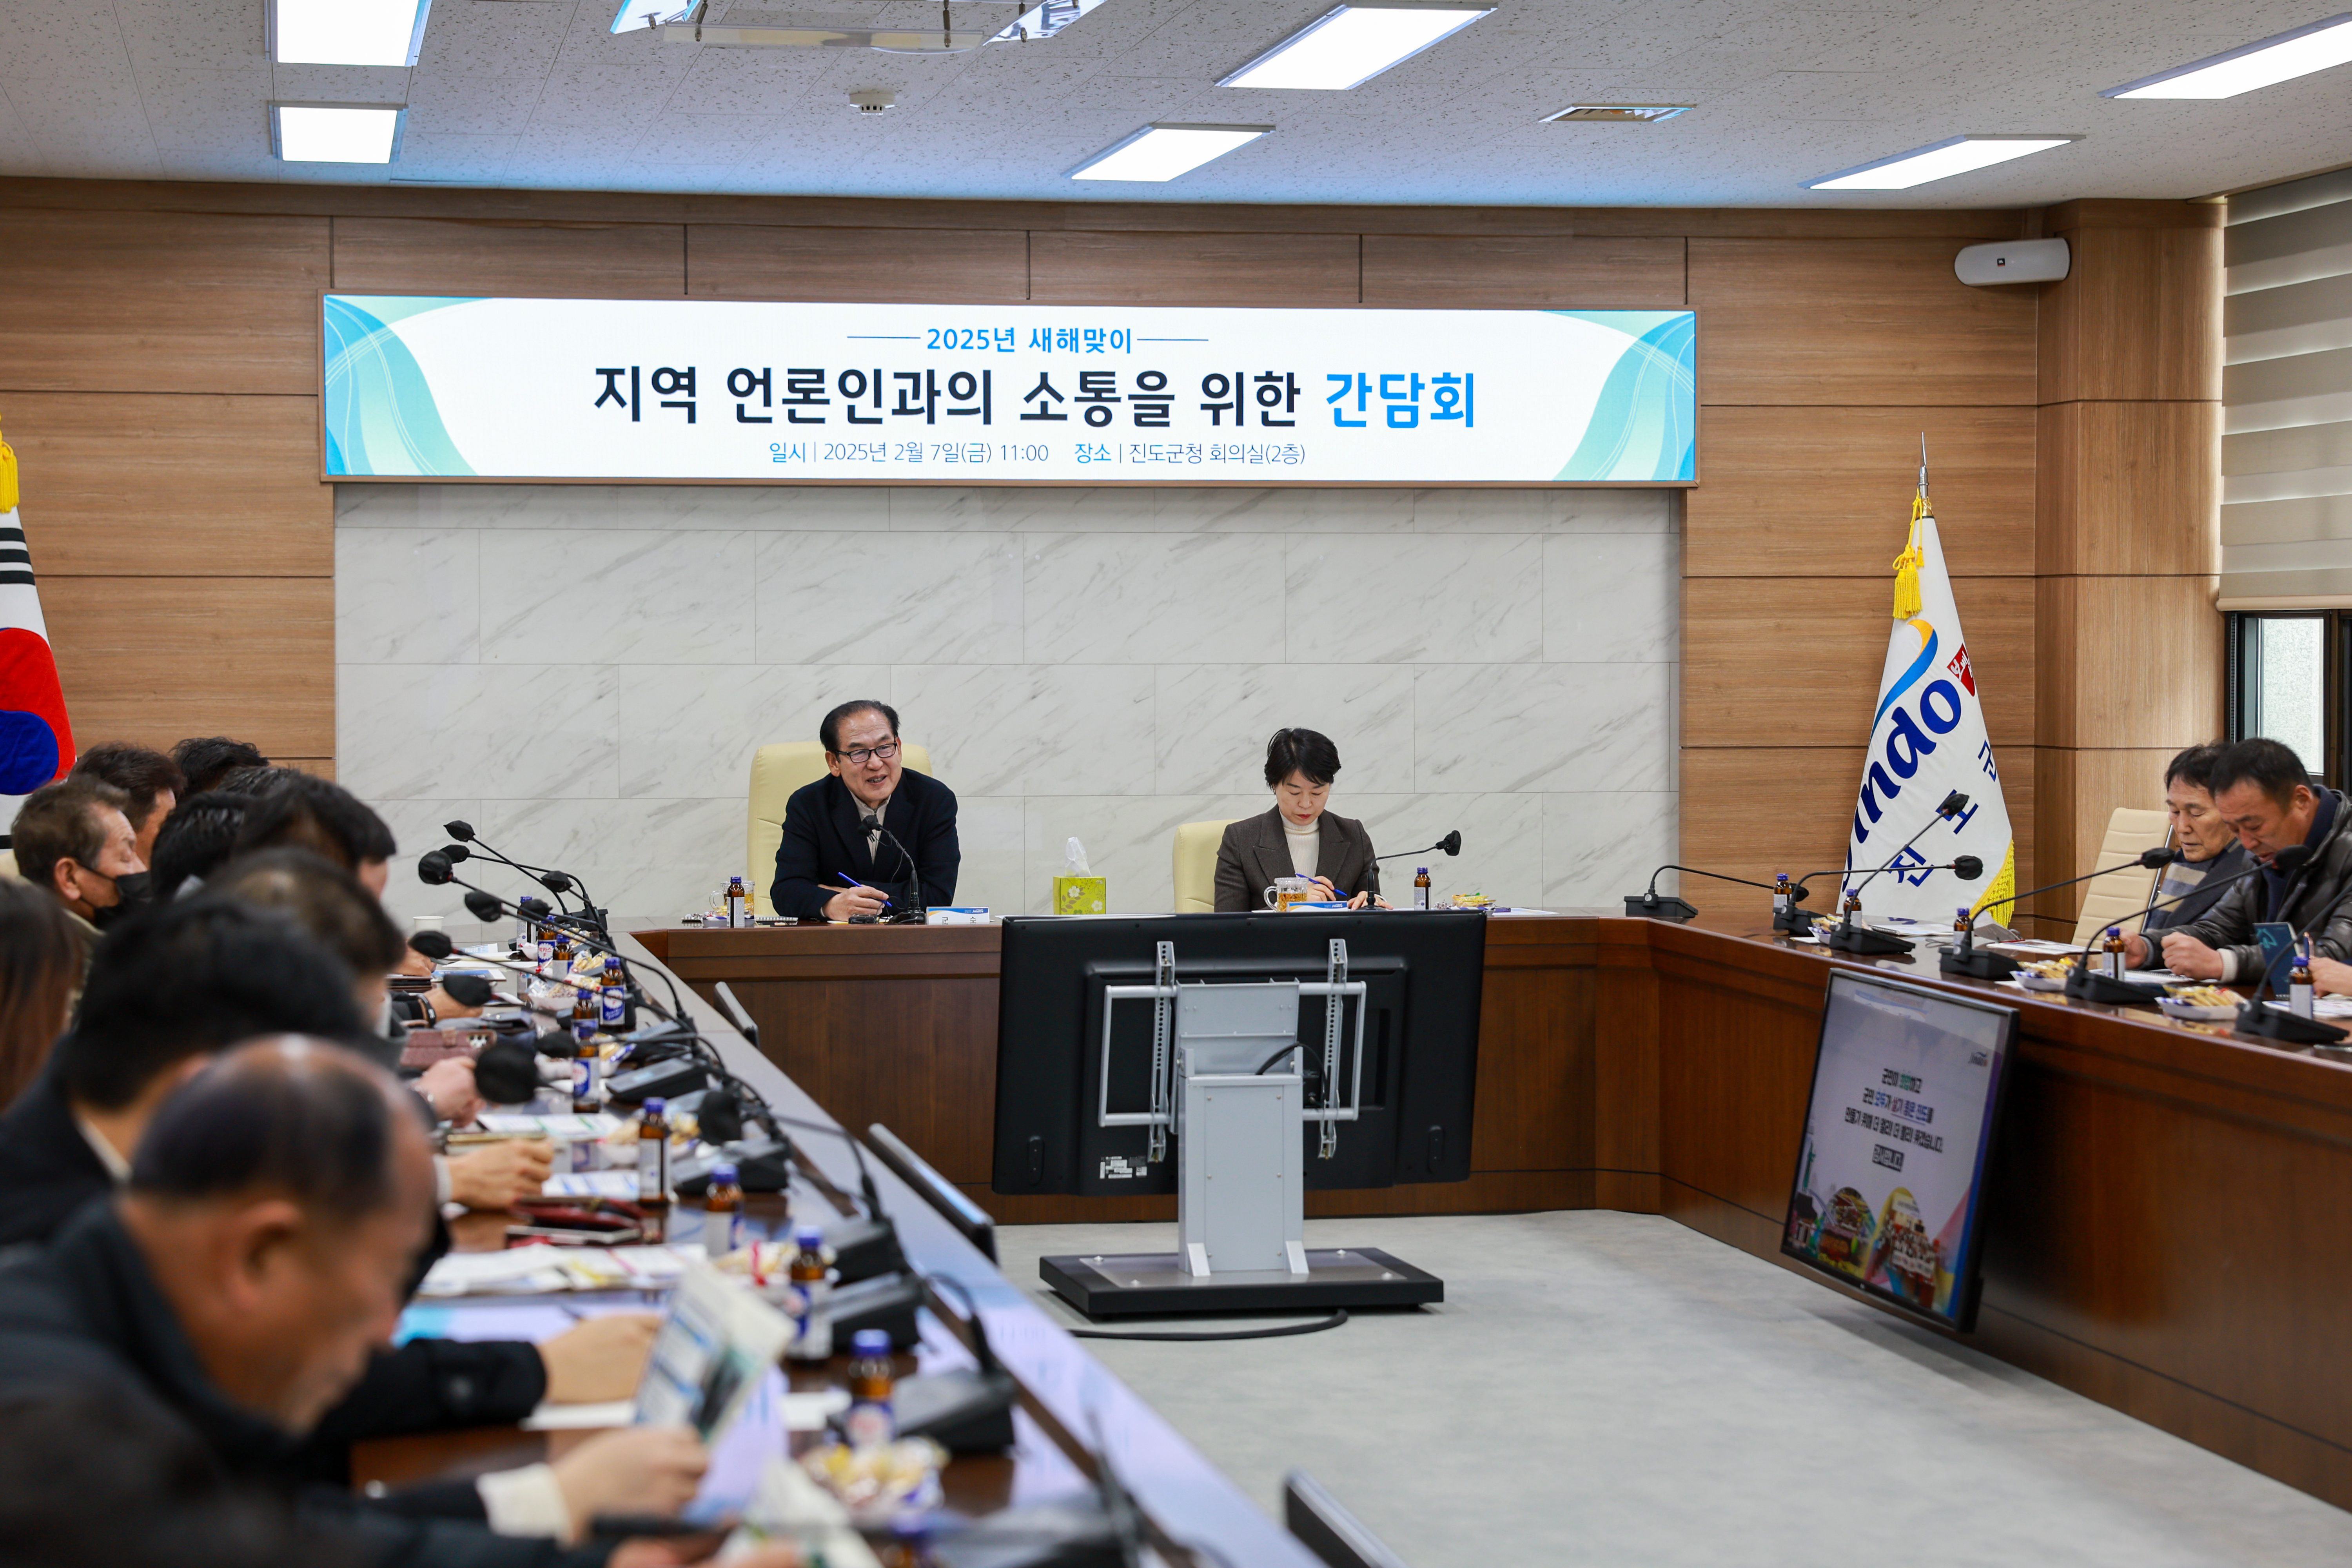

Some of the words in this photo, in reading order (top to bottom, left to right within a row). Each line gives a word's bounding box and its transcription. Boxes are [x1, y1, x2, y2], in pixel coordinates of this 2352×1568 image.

[927, 327, 1015, 353] 2025년
[1028, 327, 1132, 354] 새해맞이
[593, 365, 697, 424] 지역
[726, 367, 992, 426] 언론인과의
[1019, 370, 1176, 428] 소통을
[1200, 370, 1301, 427] 위한
[1326, 372, 1474, 429] 간담회
[769, 442, 806, 463] 일시
[824, 442, 886, 463] 2025년
[894, 441, 923, 463] 2월
[931, 442, 991, 463] 7일(금)
[1000, 444, 1049, 461] 11:00
[1074, 443, 1112, 464] 장소
[1129, 443, 1202, 465] 진도군청
[1209, 443, 1305, 465] 회의실(2층)
